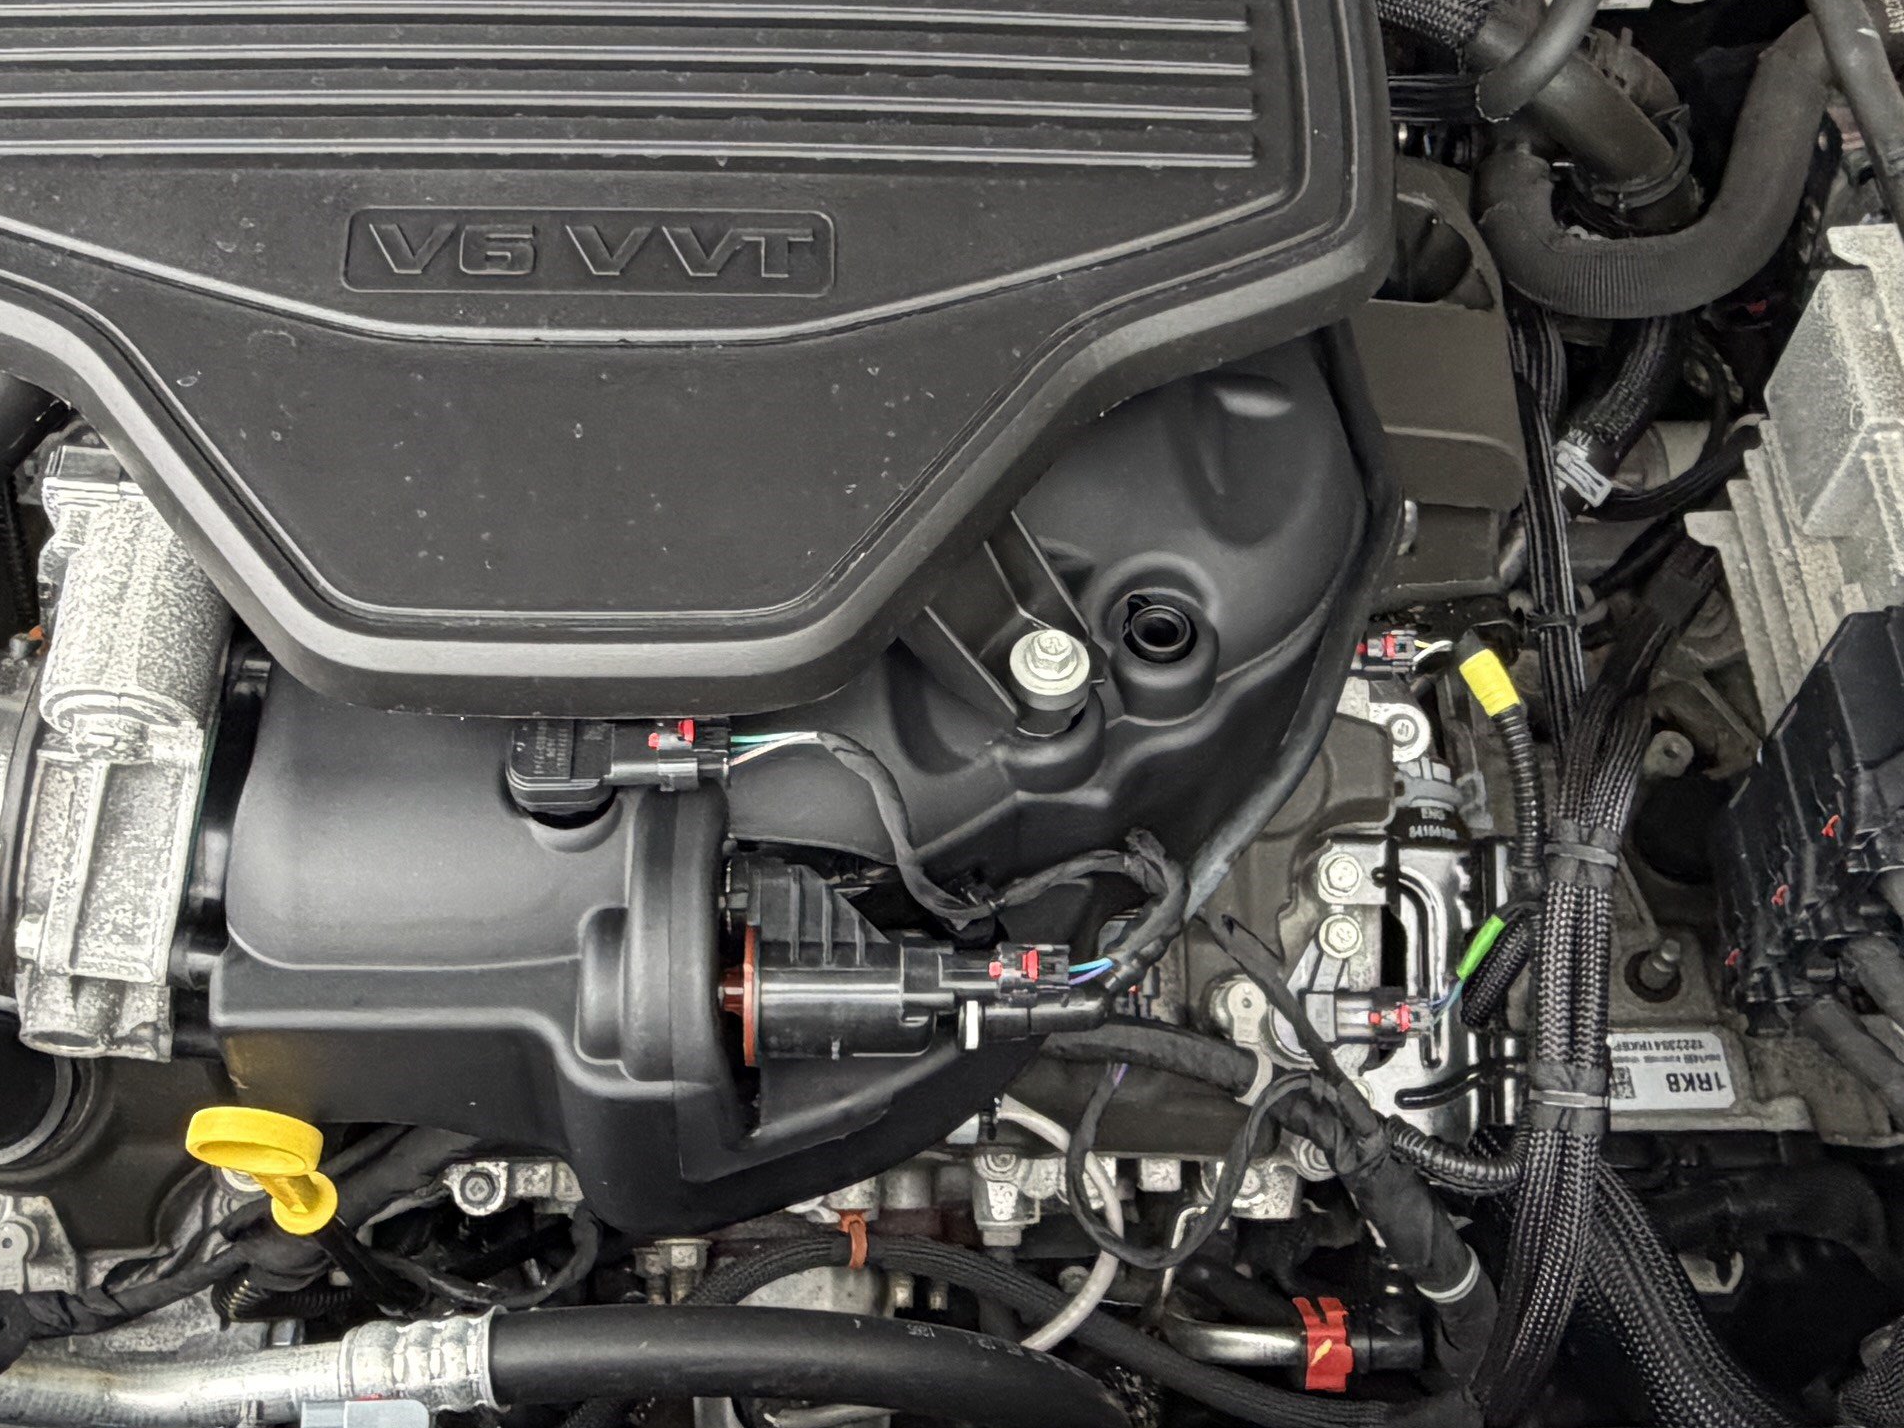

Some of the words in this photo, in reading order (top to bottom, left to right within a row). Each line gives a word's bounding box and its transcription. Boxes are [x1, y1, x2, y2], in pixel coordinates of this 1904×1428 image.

[368, 221, 537, 276] V6
[564, 224, 815, 280] VVT
[1665, 1071, 1727, 1093] 1RKB
